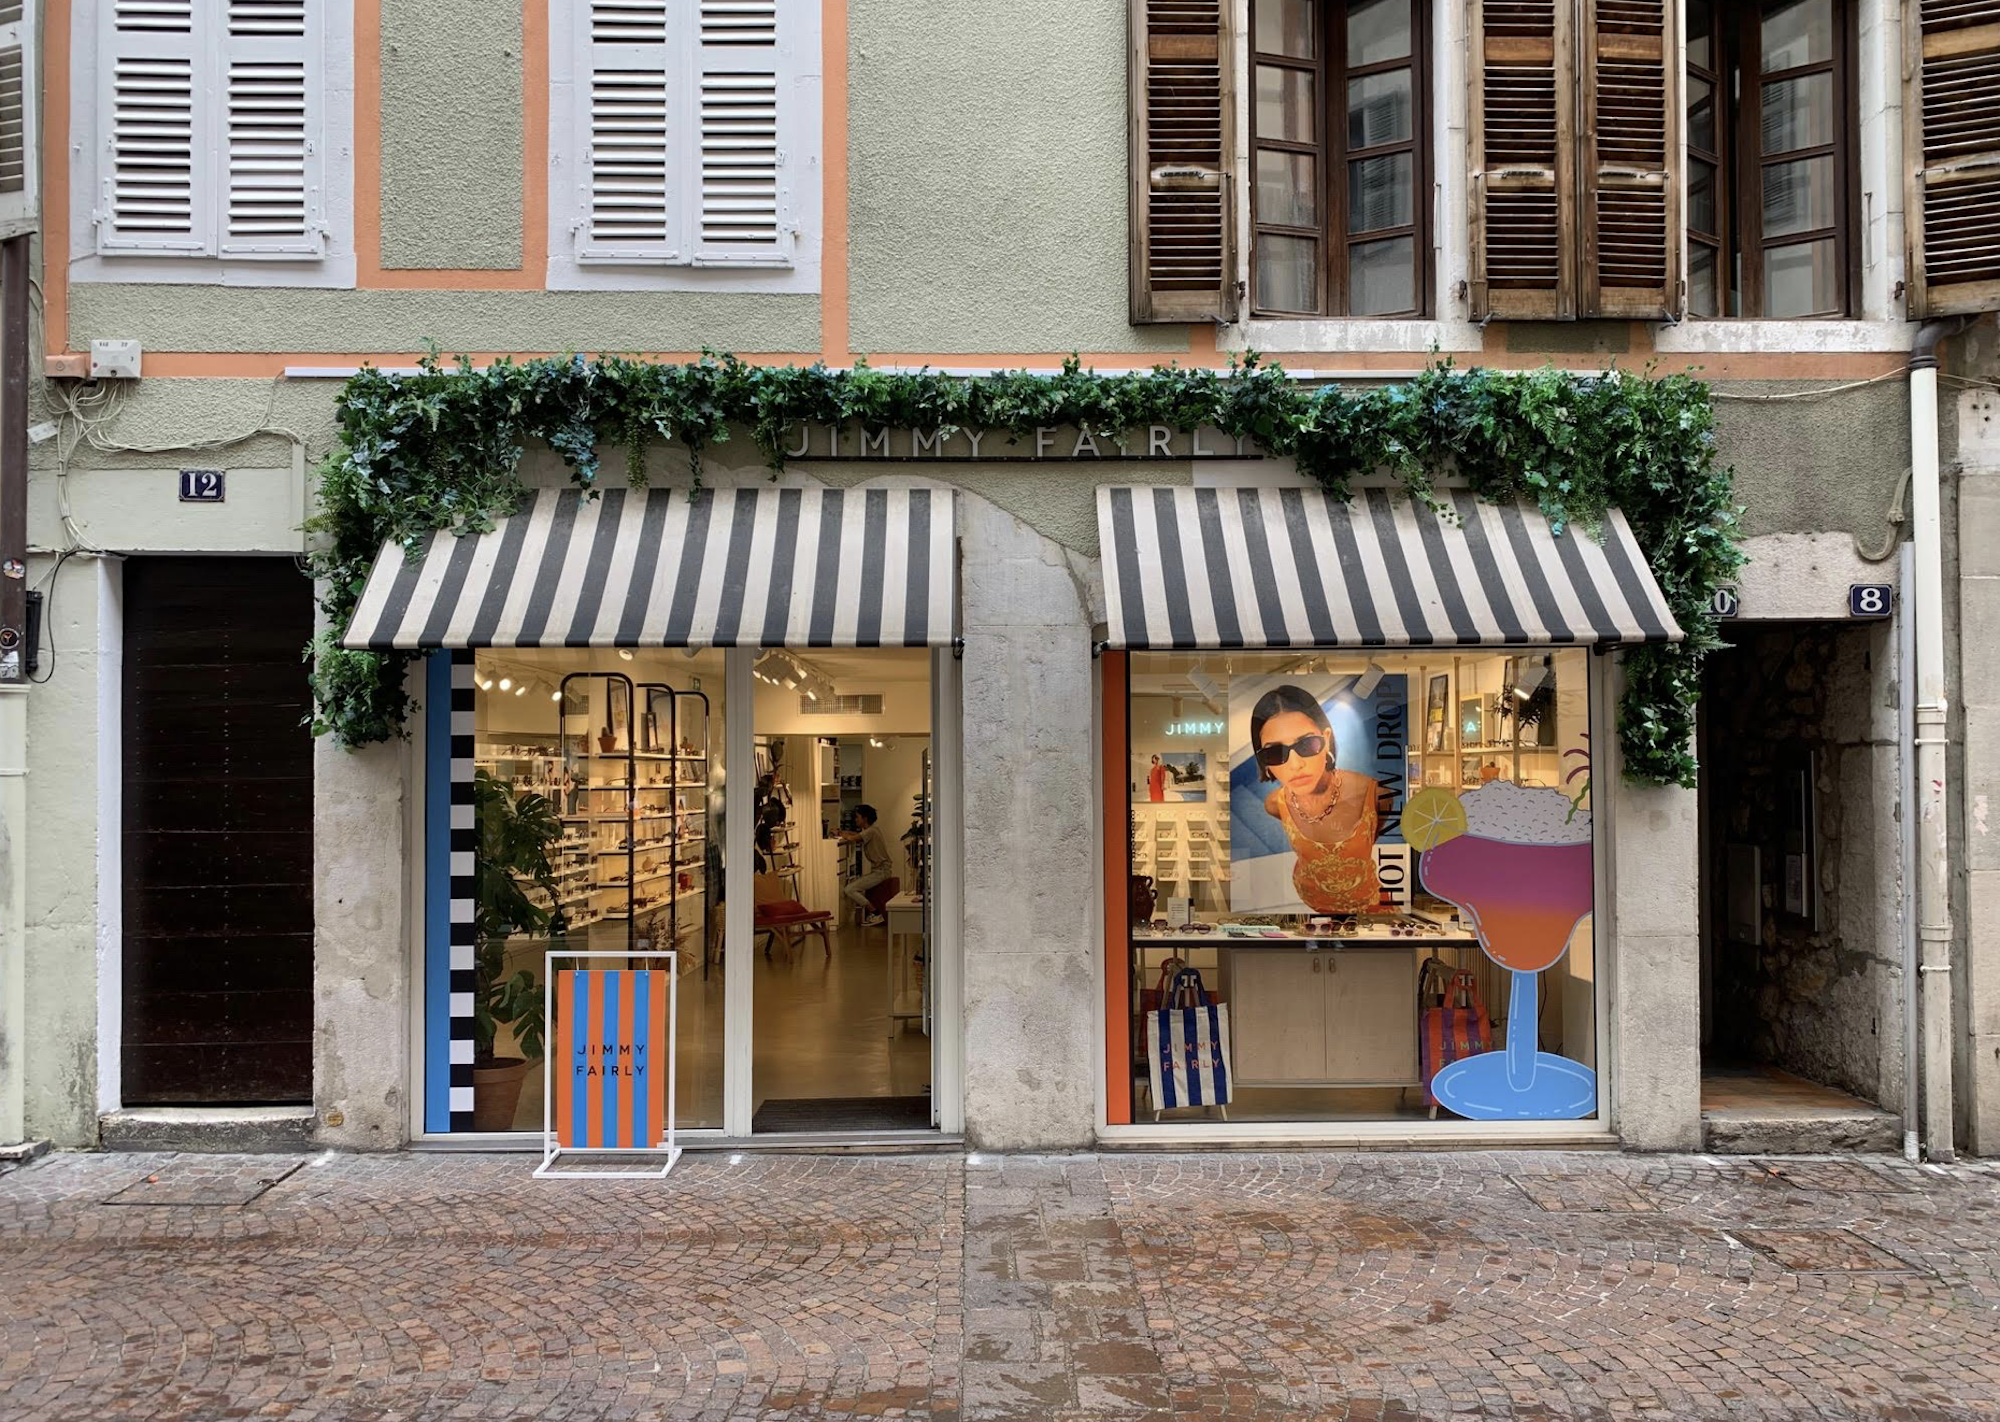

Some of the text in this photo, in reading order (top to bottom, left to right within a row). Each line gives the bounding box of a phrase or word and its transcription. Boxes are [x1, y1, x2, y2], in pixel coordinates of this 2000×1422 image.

[785, 425, 986, 457] JIMMY
[187, 472, 217, 497] 12
[1859, 587, 1883, 612] 8
[1165, 721, 1224, 736] JIMMY
[1376, 681, 1404, 907] HOT NEW DROP
[577, 1044, 645, 1055] JIMMY
[1163, 1040, 1218, 1054] JIMMY
[576, 1065, 645, 1076] FAIRLY
